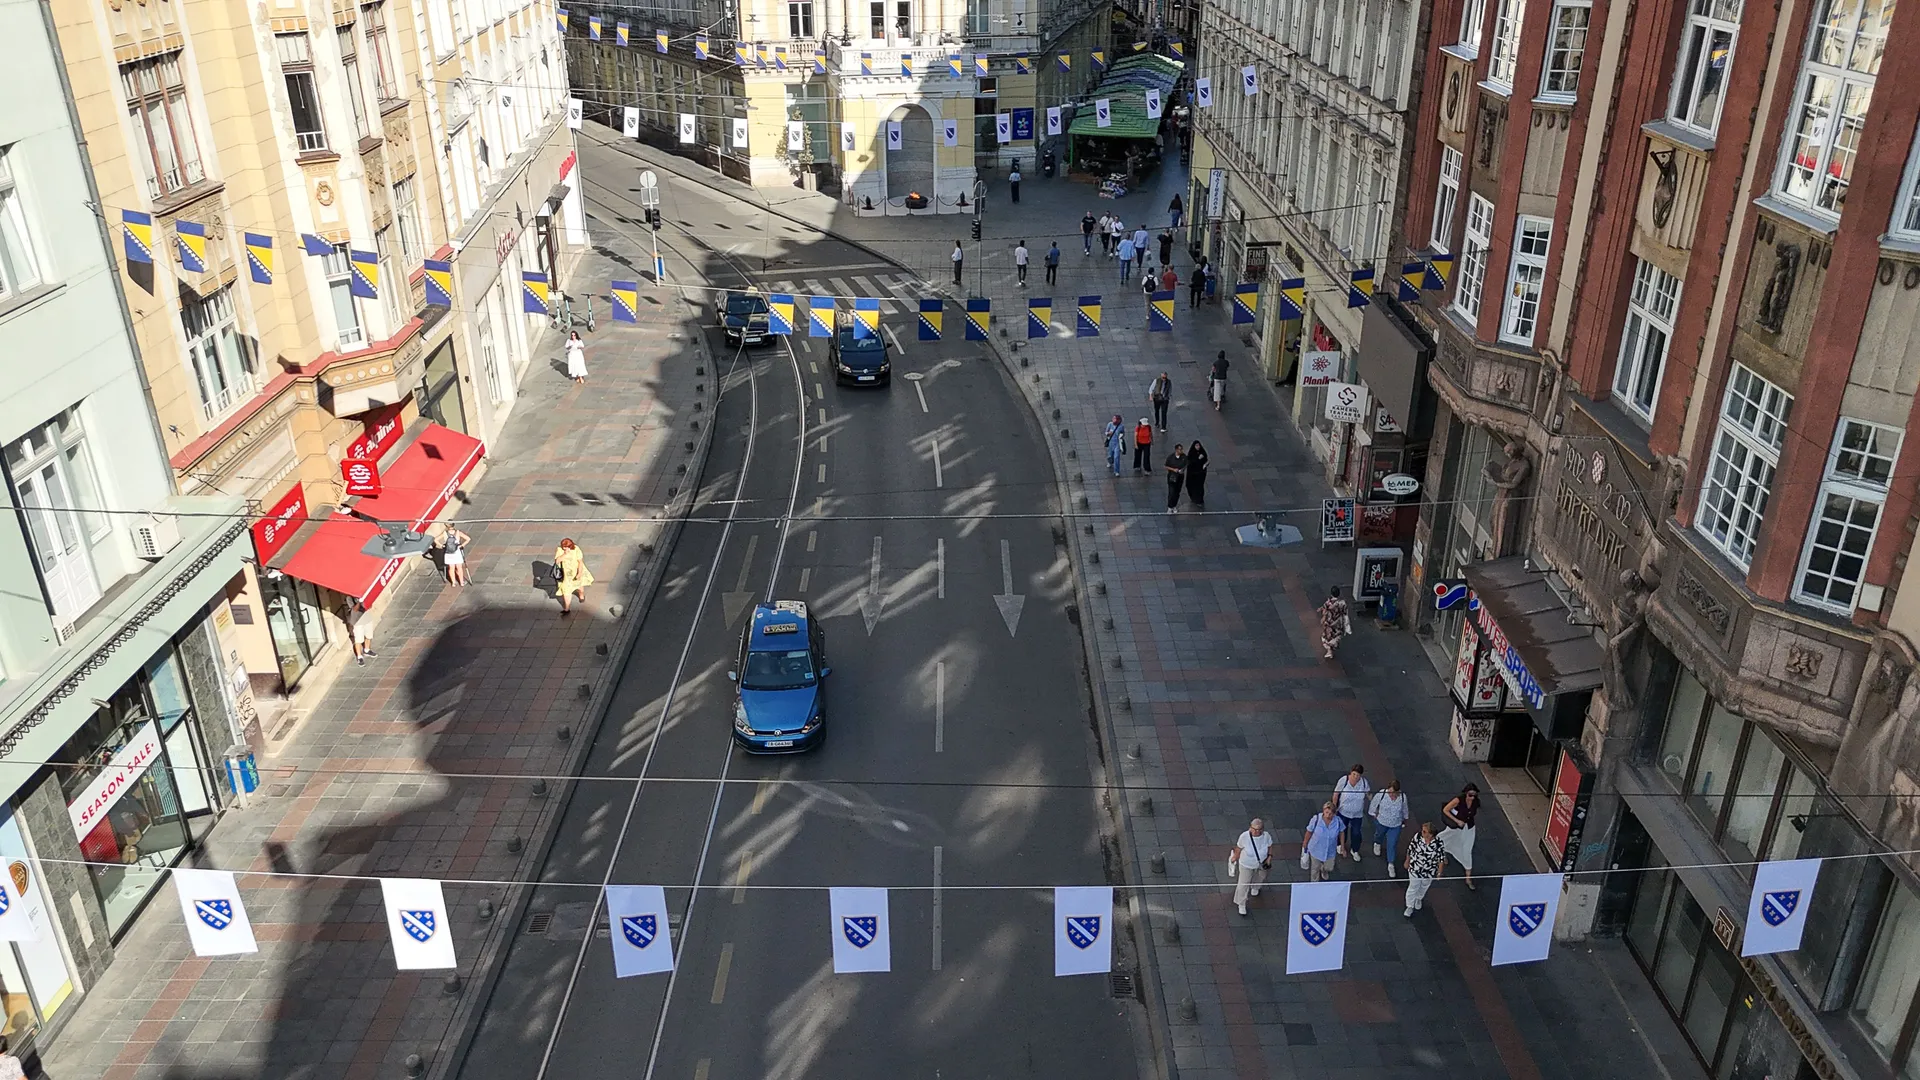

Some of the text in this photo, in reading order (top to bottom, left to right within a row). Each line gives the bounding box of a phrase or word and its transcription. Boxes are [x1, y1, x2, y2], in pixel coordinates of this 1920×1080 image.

[1247, 258, 1265, 266] FOOD
[1248, 249, 1266, 258] FINE
[366, 417, 396, 455] alpina
[1564, 443, 1586, 484] 1902
[275, 500, 301, 531] alpina
[1555, 480, 1625, 570] NAPREDAK
[1477, 604, 1545, 710] INTERSPORT
[81, 771, 125, 825] SEASON
[127, 742, 153, 774] SALE
